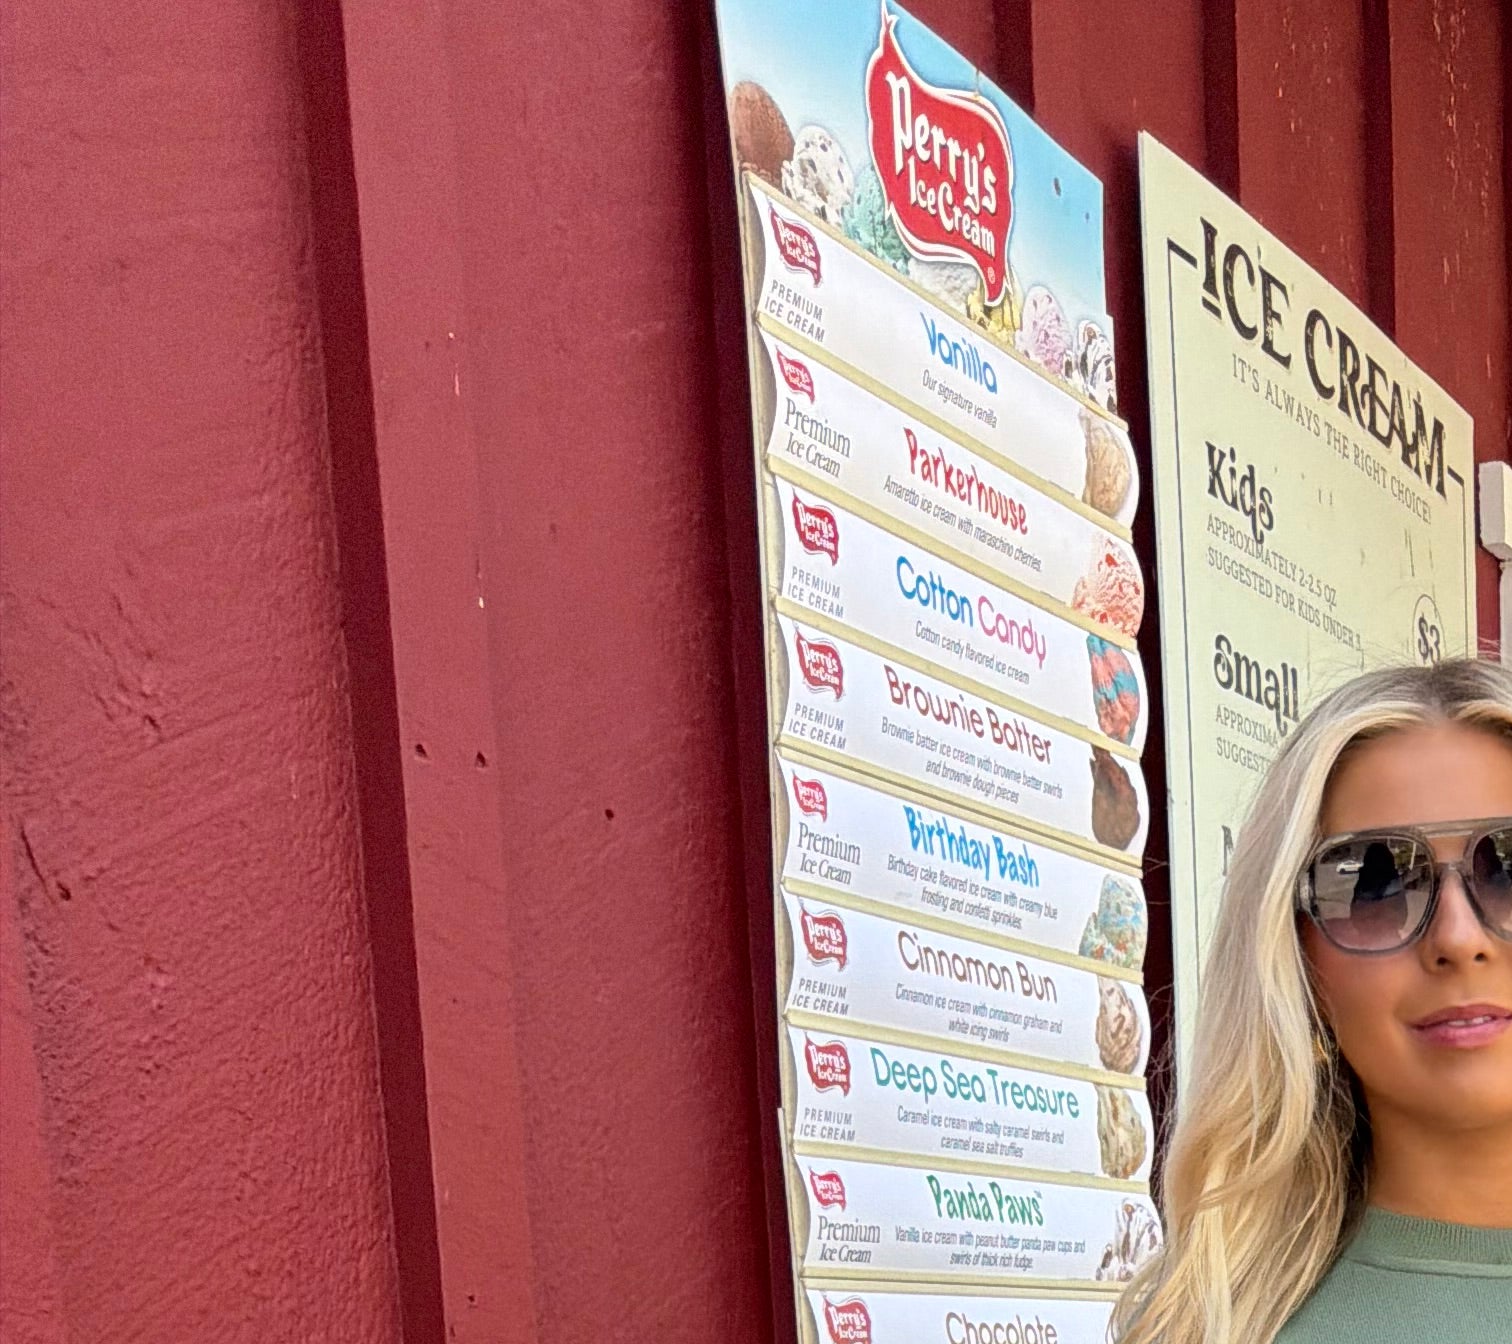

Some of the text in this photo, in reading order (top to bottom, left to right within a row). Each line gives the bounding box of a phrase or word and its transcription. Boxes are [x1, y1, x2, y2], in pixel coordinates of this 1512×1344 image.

[886, 71, 997, 216] Perry's
[765, 296, 825, 343] ICE CREAM
[770, 280, 823, 320] PREMIUM
[920, 312, 998, 394] Vanilla
[1200, 216, 1447, 499] ICE CREAM
[922, 370, 997, 429] Our signature vanilla
[785, 397, 851, 458] Premium
[1232, 353, 1431, 525] IT'S ALWAYS THE RIGHT CHOICE!
[786, 433, 840, 478] Ice Cream
[903, 427, 1028, 535] Parkerhouse
[1205, 441, 1274, 544] Kids
[796, 501, 834, 540] Perry's
[884, 474, 919, 509] Amaretto
[920, 493, 931, 514] ice
[932, 500, 956, 527] cream
[958, 514, 974, 535] with
[974, 525, 1014, 557] maraschino
[1206, 514, 1297, 583] APPROXIMATELY
[787, 583, 844, 618] ICE CREAM
[791, 566, 841, 599] PREMIUM
[1207, 547, 1272, 600] SUGGESTED
[1275, 584, 1296, 613] FOR
[1297, 597, 1320, 628] KIDS
[1322, 613, 1354, 649] UNDER
[896, 555, 1046, 670] Cotton Candy
[800, 639, 838, 674] Perry's
[915, 620, 1030, 685] Cotton candy flavored ice cream
[1417, 611, 1441, 666] $3
[1213, 634, 1299, 737] Small
[788, 720, 846, 750] ICE CREAM
[794, 703, 844, 732] PREMIUM
[884, 664, 1051, 764] Brownie Batter
[881, 716, 913, 744] Brownie
[916, 727, 938, 751] batter
[939, 735, 951, 757] ice
[952, 744, 975, 765] cream
[976, 748, 992, 768] with
[993, 752, 1020, 781] brownie
[1021, 765, 1041, 790] batter
[925, 758, 1019, 804] and brownie dough pieces
[797, 821, 861, 866] Premium
[903, 804, 1039, 887] Birthday Bash
[800, 853, 851, 885] Ice Cream
[888, 853, 1058, 920] Birthday cake flavored ice cream with creamy blue
[804, 915, 842, 944] Perry's
[799, 978, 847, 999] PREMIUM
[898, 930, 1057, 1003] Cinnamon Bun
[792, 994, 849, 1016] ICE CREAM
[895, 982, 1063, 1034] Cinnamon ice cream with cinnamon graham and
[808, 1044, 847, 1073] Perry's
[870, 1047, 1080, 1118] Deep Sea Treasure
[800, 1124, 856, 1142] ICE CREAM
[804, 1108, 852, 1125] PREMIUM
[926, 1175, 989, 1221] Panda
[817, 1215, 881, 1244] Premium
[819, 1244, 872, 1264] Ice Cream
[828, 1306, 867, 1334] Perry's
